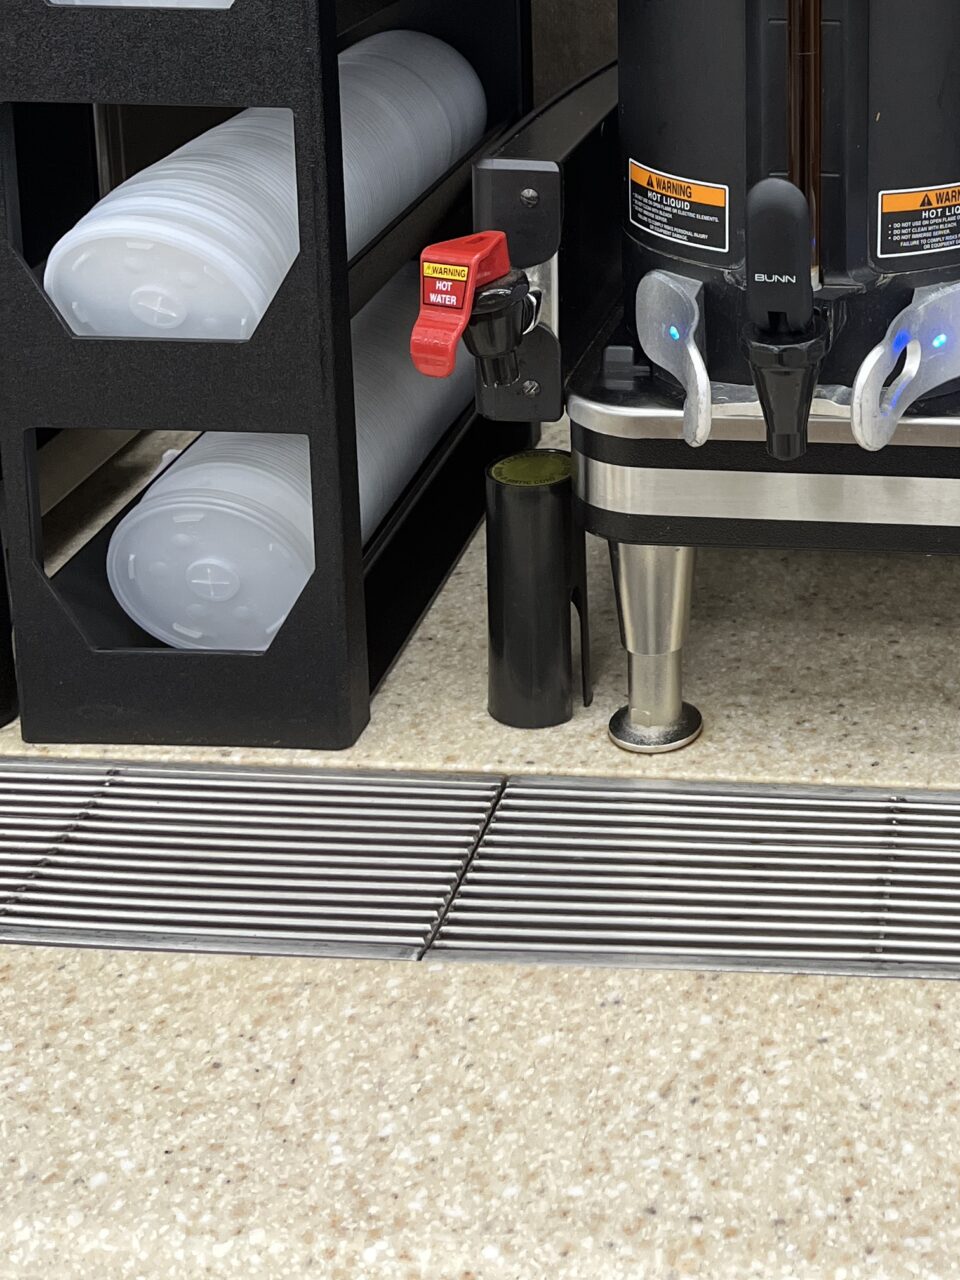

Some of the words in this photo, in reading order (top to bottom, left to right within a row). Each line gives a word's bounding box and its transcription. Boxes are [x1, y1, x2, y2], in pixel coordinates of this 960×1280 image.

[655, 177, 692, 198] WARNING
[647, 191, 661, 202] HOT
[663, 196, 690, 210] LIQUID
[922, 208, 942, 219] HOT
[432, 267, 466, 278] WARNING
[754, 273, 796, 283] BUNN
[435, 280, 453, 291] HOT
[429, 293, 457, 305] WATER
